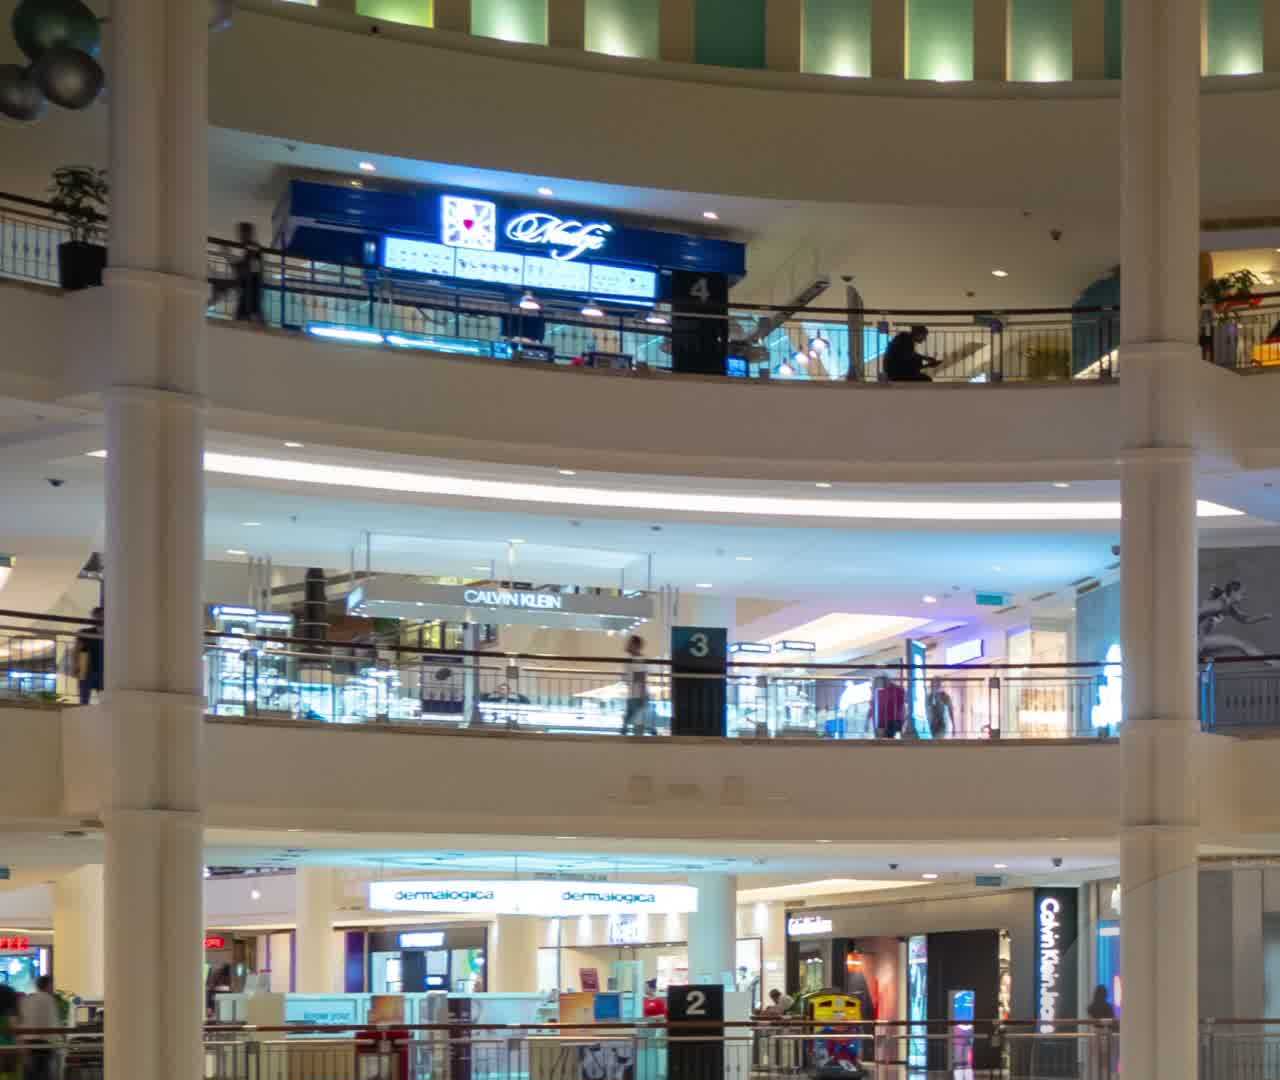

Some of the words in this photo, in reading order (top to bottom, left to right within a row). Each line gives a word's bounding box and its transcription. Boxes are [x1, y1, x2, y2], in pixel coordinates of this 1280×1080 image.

[690, 279, 710, 301] 4
[464, 590, 520, 606] CALVIN
[521, 593, 561, 609] KLEIN
[689, 632, 709, 657] 3
[394, 888, 495, 902] dermalogica
[562, 890, 656, 904] dermalogica
[1040, 898, 1060, 948] Calvin
[1040, 949, 1060, 987] Klein
[686, 991, 705, 1015] 2
